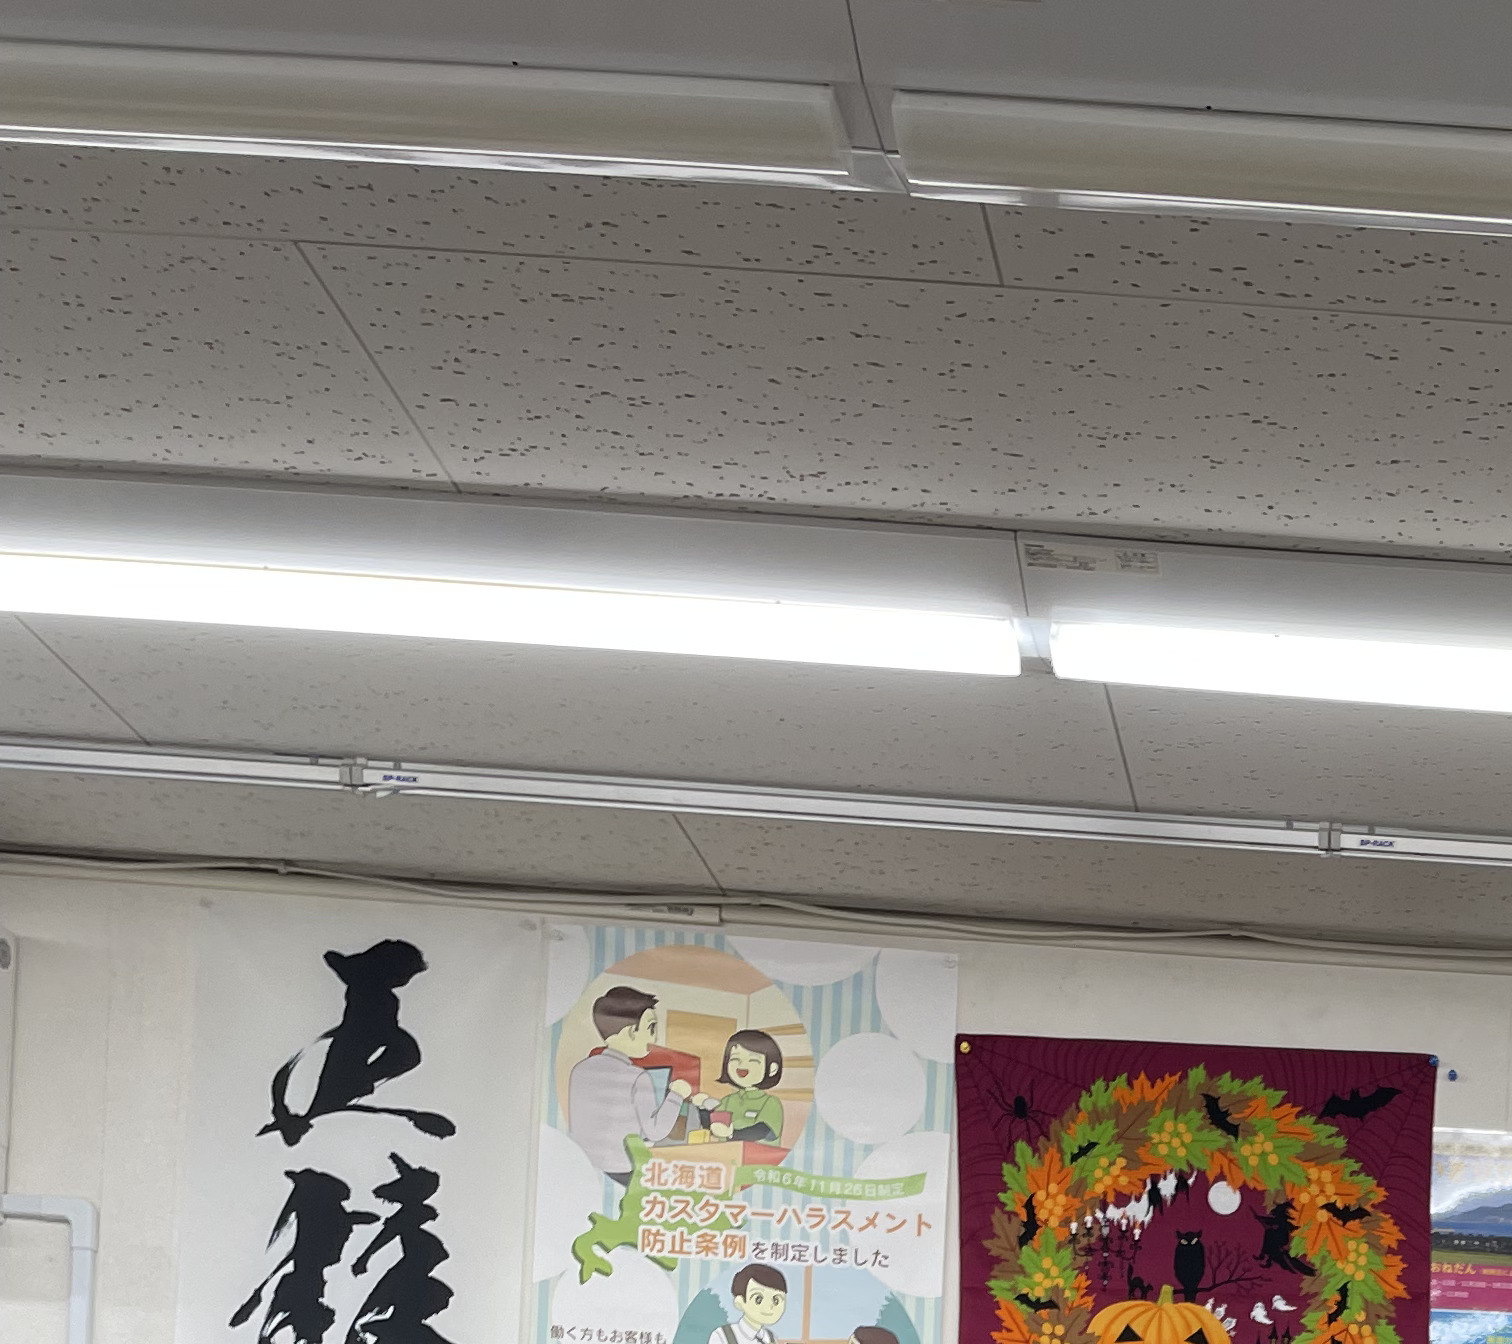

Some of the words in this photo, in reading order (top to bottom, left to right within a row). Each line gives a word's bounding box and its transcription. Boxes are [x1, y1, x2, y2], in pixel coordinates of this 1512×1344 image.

[642, 1161, 726, 1191] 北海道
[640, 1195, 932, 1238] カスタマーハラスメント
[640, 1228, 890, 1269] 防止条例を制定しました
